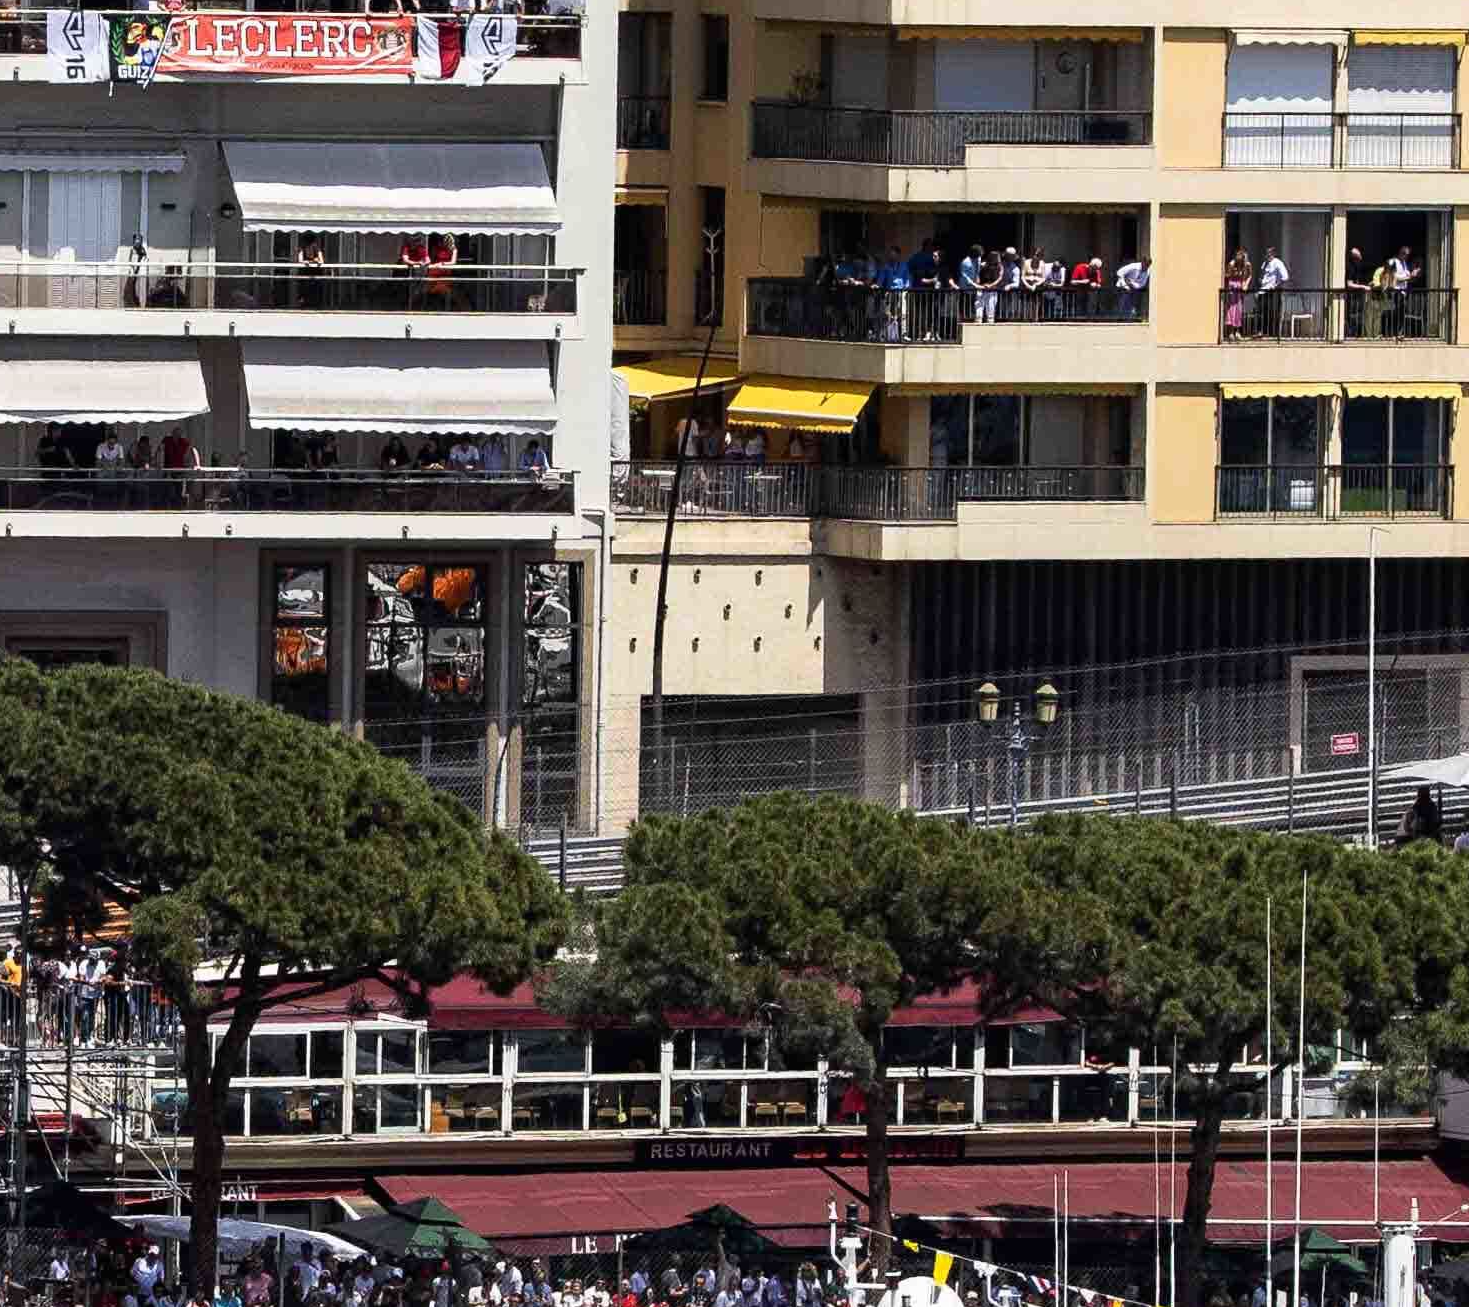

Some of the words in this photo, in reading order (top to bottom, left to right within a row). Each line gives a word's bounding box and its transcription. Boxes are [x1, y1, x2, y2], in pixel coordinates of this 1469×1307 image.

[187, 19, 373, 60] LECLERC
[65, 54, 86, 79] 16
[649, 1141, 774, 1159] RESTAURANT
